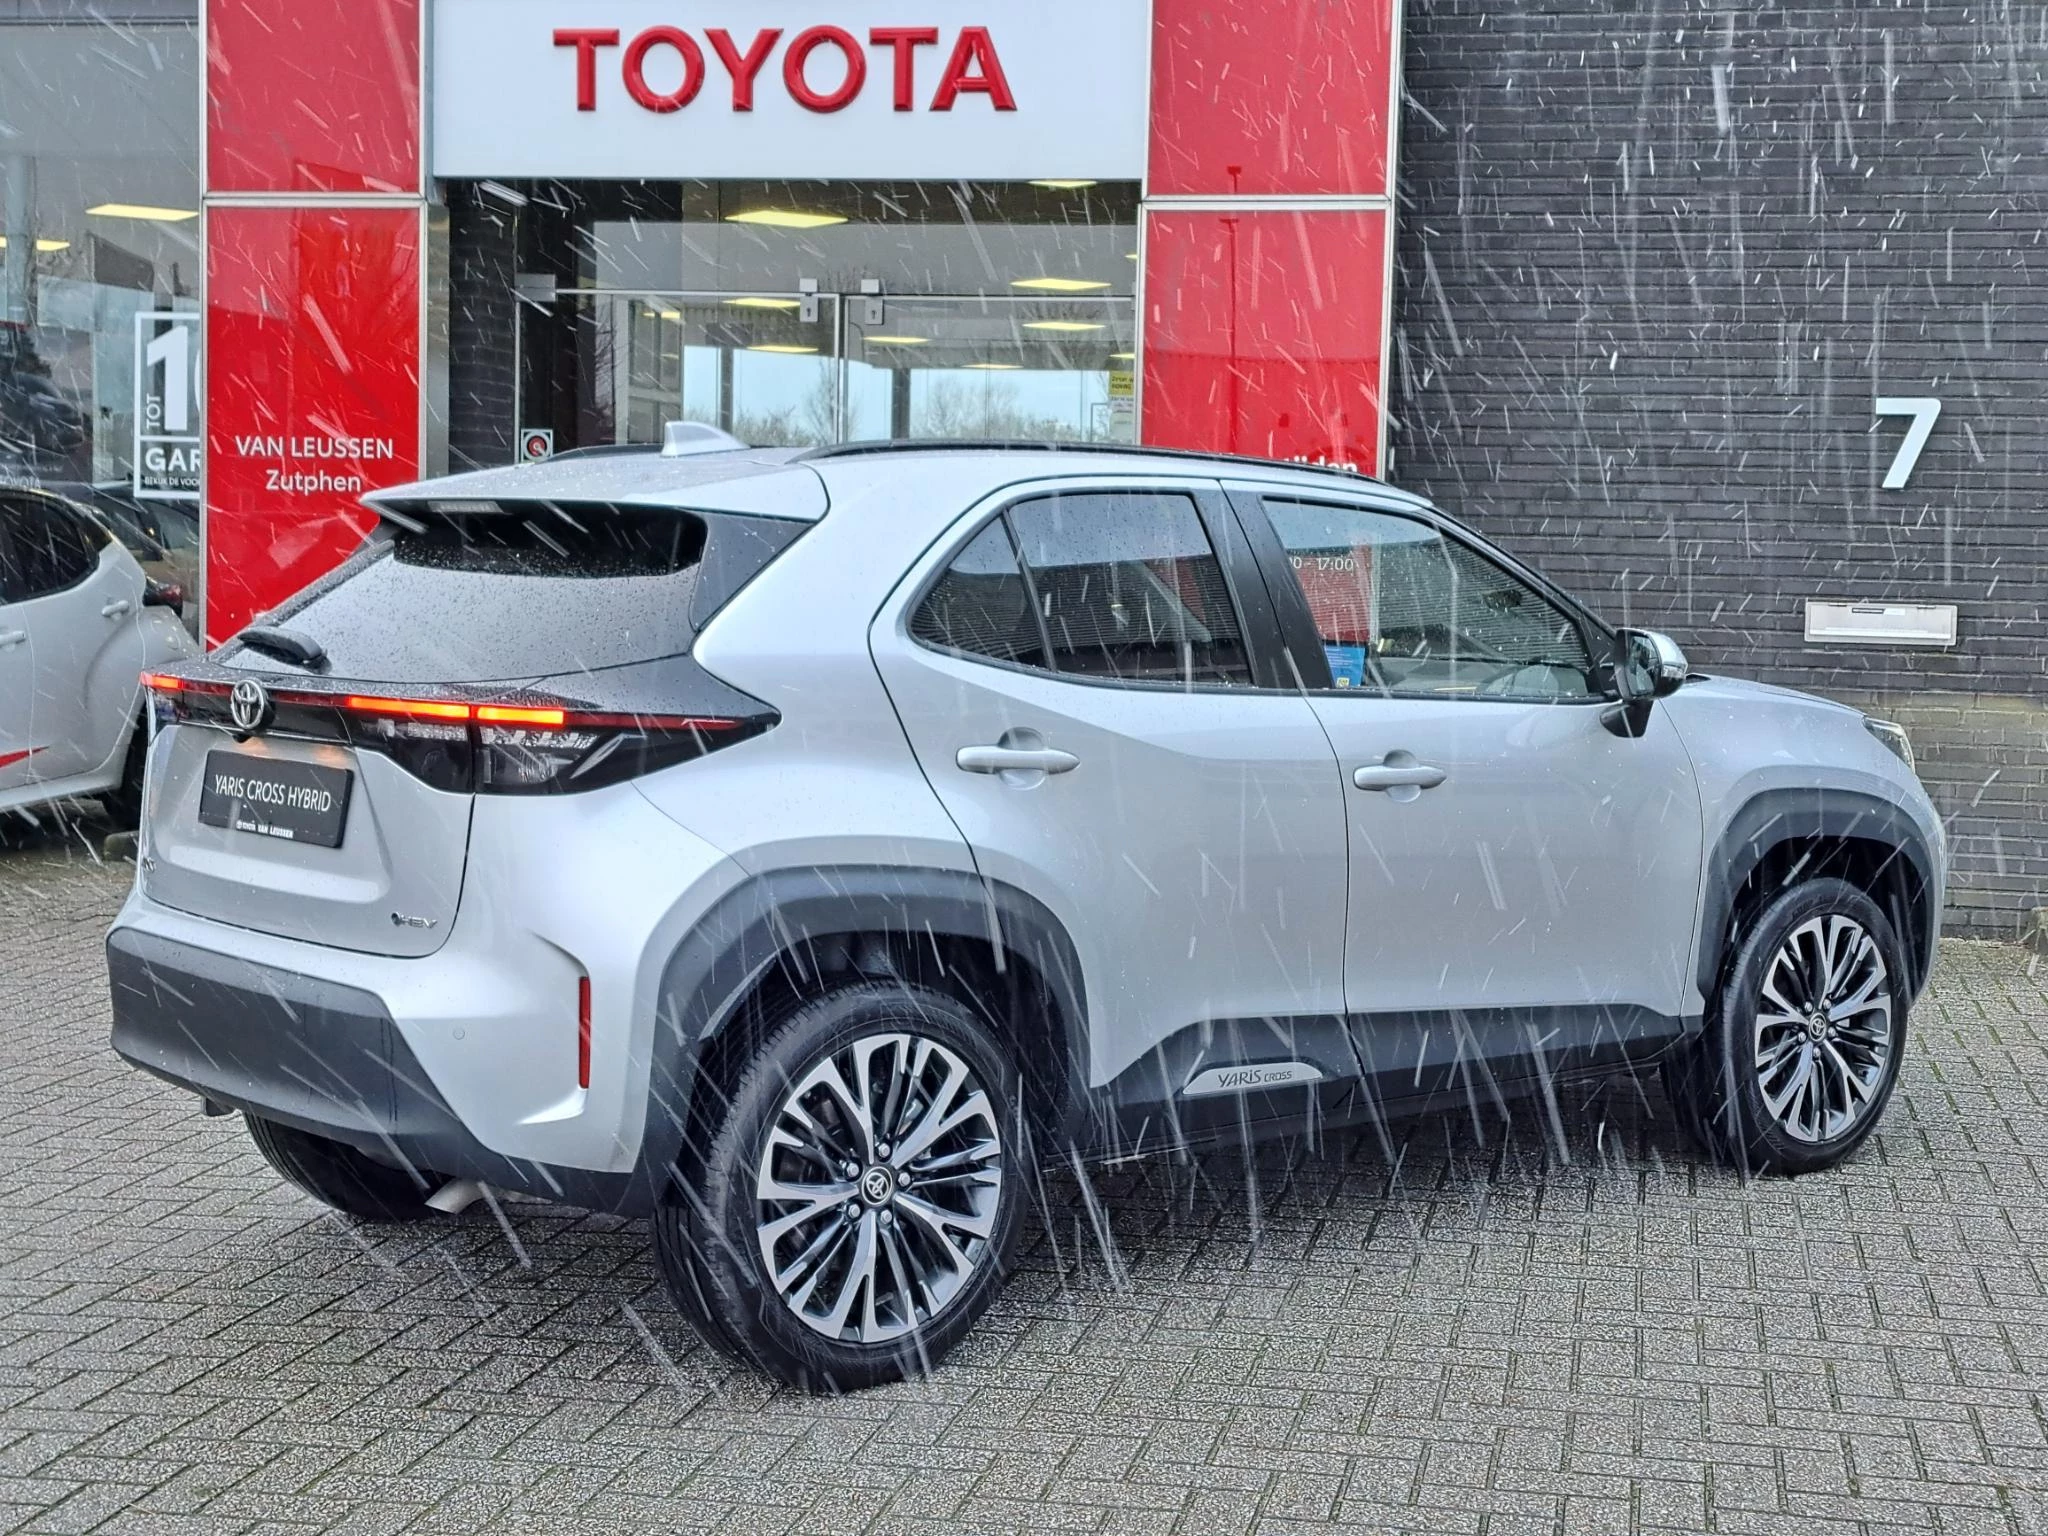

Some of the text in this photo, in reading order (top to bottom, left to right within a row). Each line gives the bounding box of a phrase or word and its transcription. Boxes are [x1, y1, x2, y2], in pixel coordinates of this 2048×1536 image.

[553, 25, 1018, 114] TOYOTA
[146, 325, 200, 431] 1
[146, 393, 161, 430] TOT
[235, 435, 394, 459] VAN LEUSSEN
[1876, 397, 1942, 489] 7
[265, 468, 361, 497] Zutphen
[1317, 557, 1354, 571] 17:00
[215, 774, 331, 812] YARIS CROSS HYBRID
[1264, 1071, 1293, 1083] CROSS
